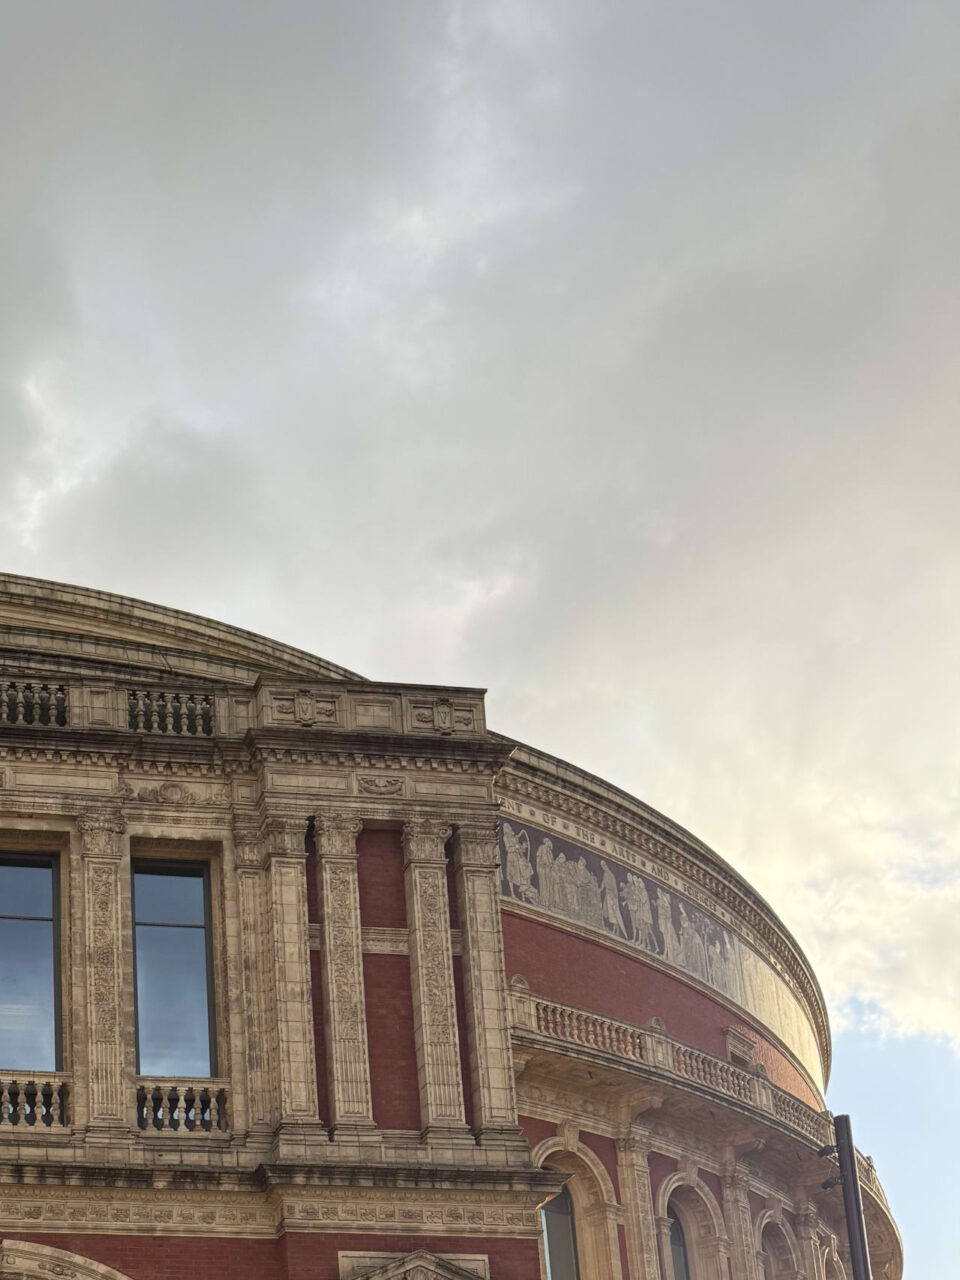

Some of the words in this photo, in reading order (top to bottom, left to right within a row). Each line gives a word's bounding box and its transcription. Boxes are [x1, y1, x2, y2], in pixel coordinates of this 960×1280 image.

[542, 813, 557, 826] OF
[574, 825, 596, 844] THE
[612, 845, 637, 863] ARTS
[651, 866, 670, 881] AND
